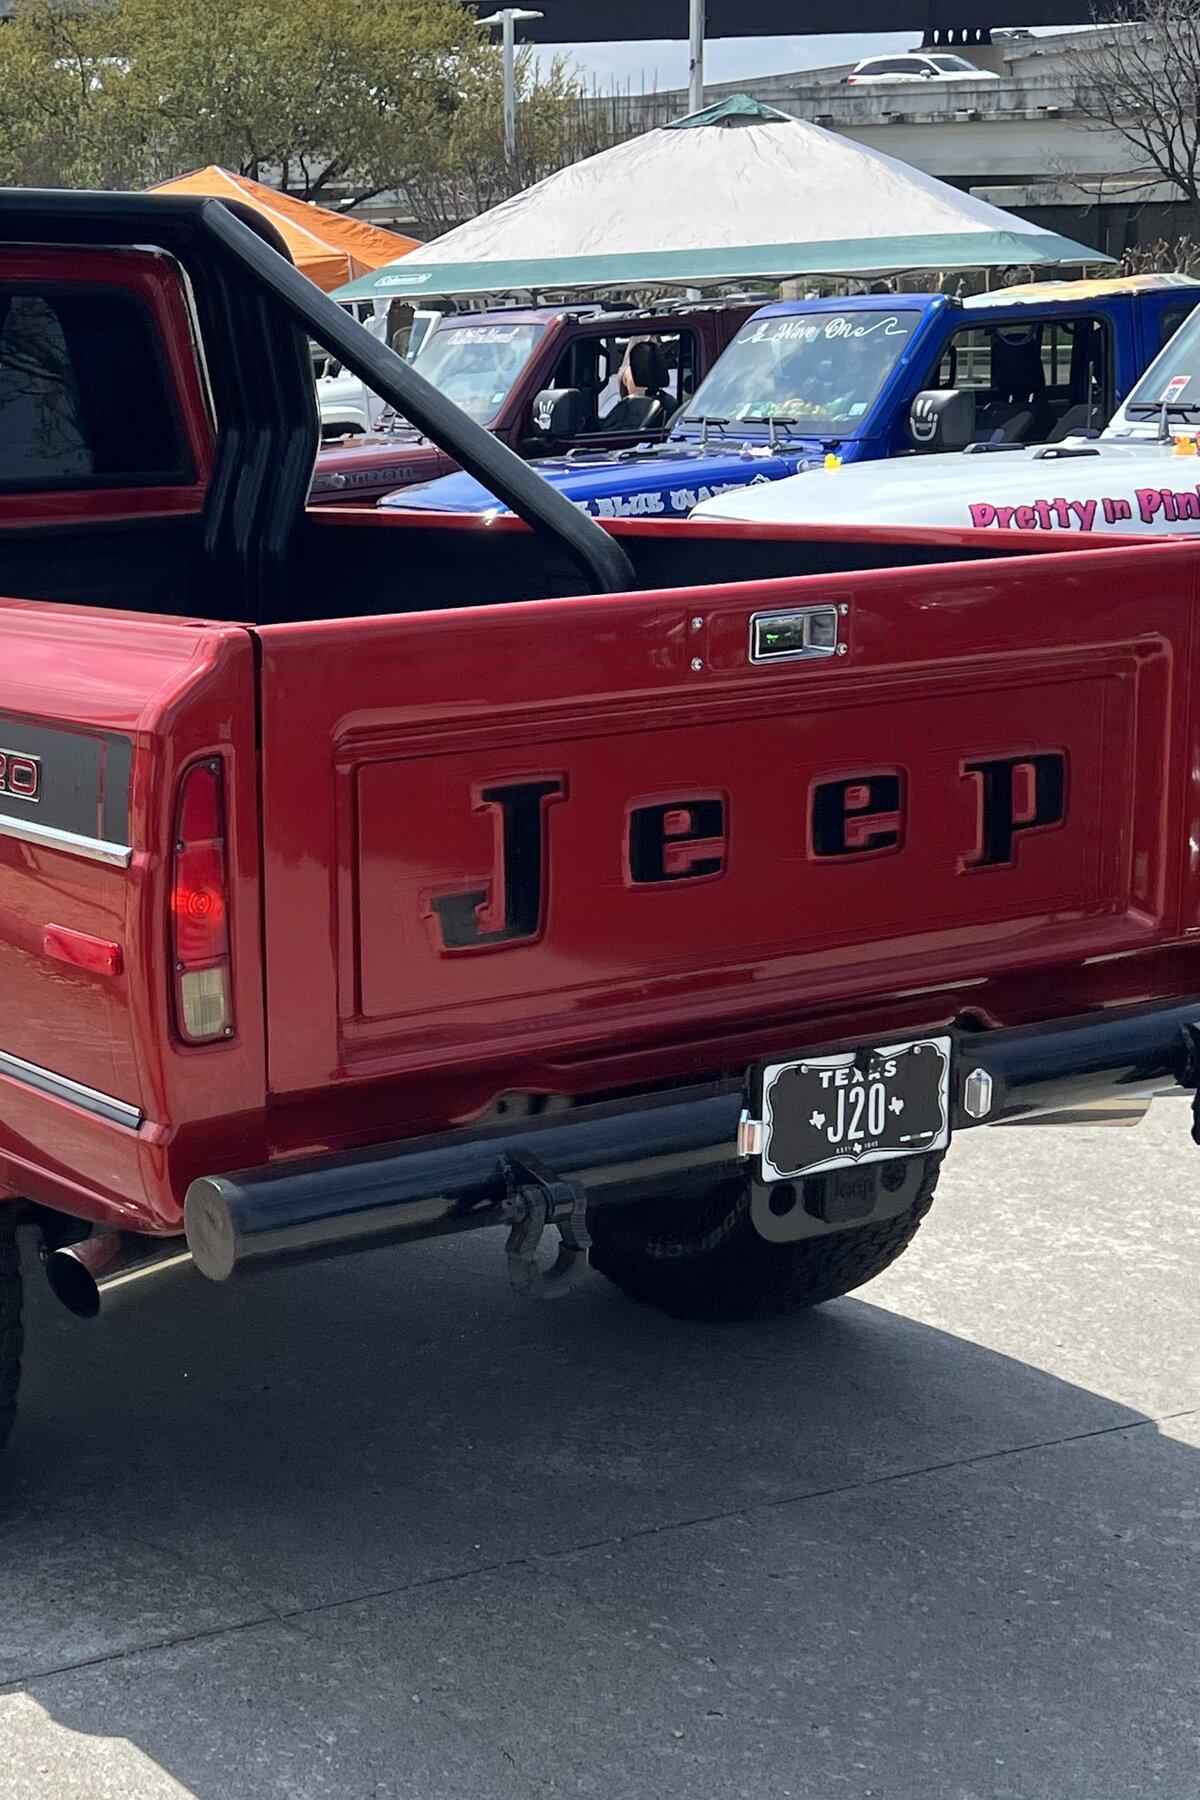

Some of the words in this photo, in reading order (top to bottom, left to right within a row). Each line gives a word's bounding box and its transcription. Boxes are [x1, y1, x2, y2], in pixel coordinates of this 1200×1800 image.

[595, 492, 665, 517] BLUE
[968, 498, 1097, 531] Pretty
[1101, 498, 1132, 524] In
[1135, 484, 1200, 524] Pin
[420, 747, 1069, 957] Jeep
[826, 1082, 886, 1143] J20
